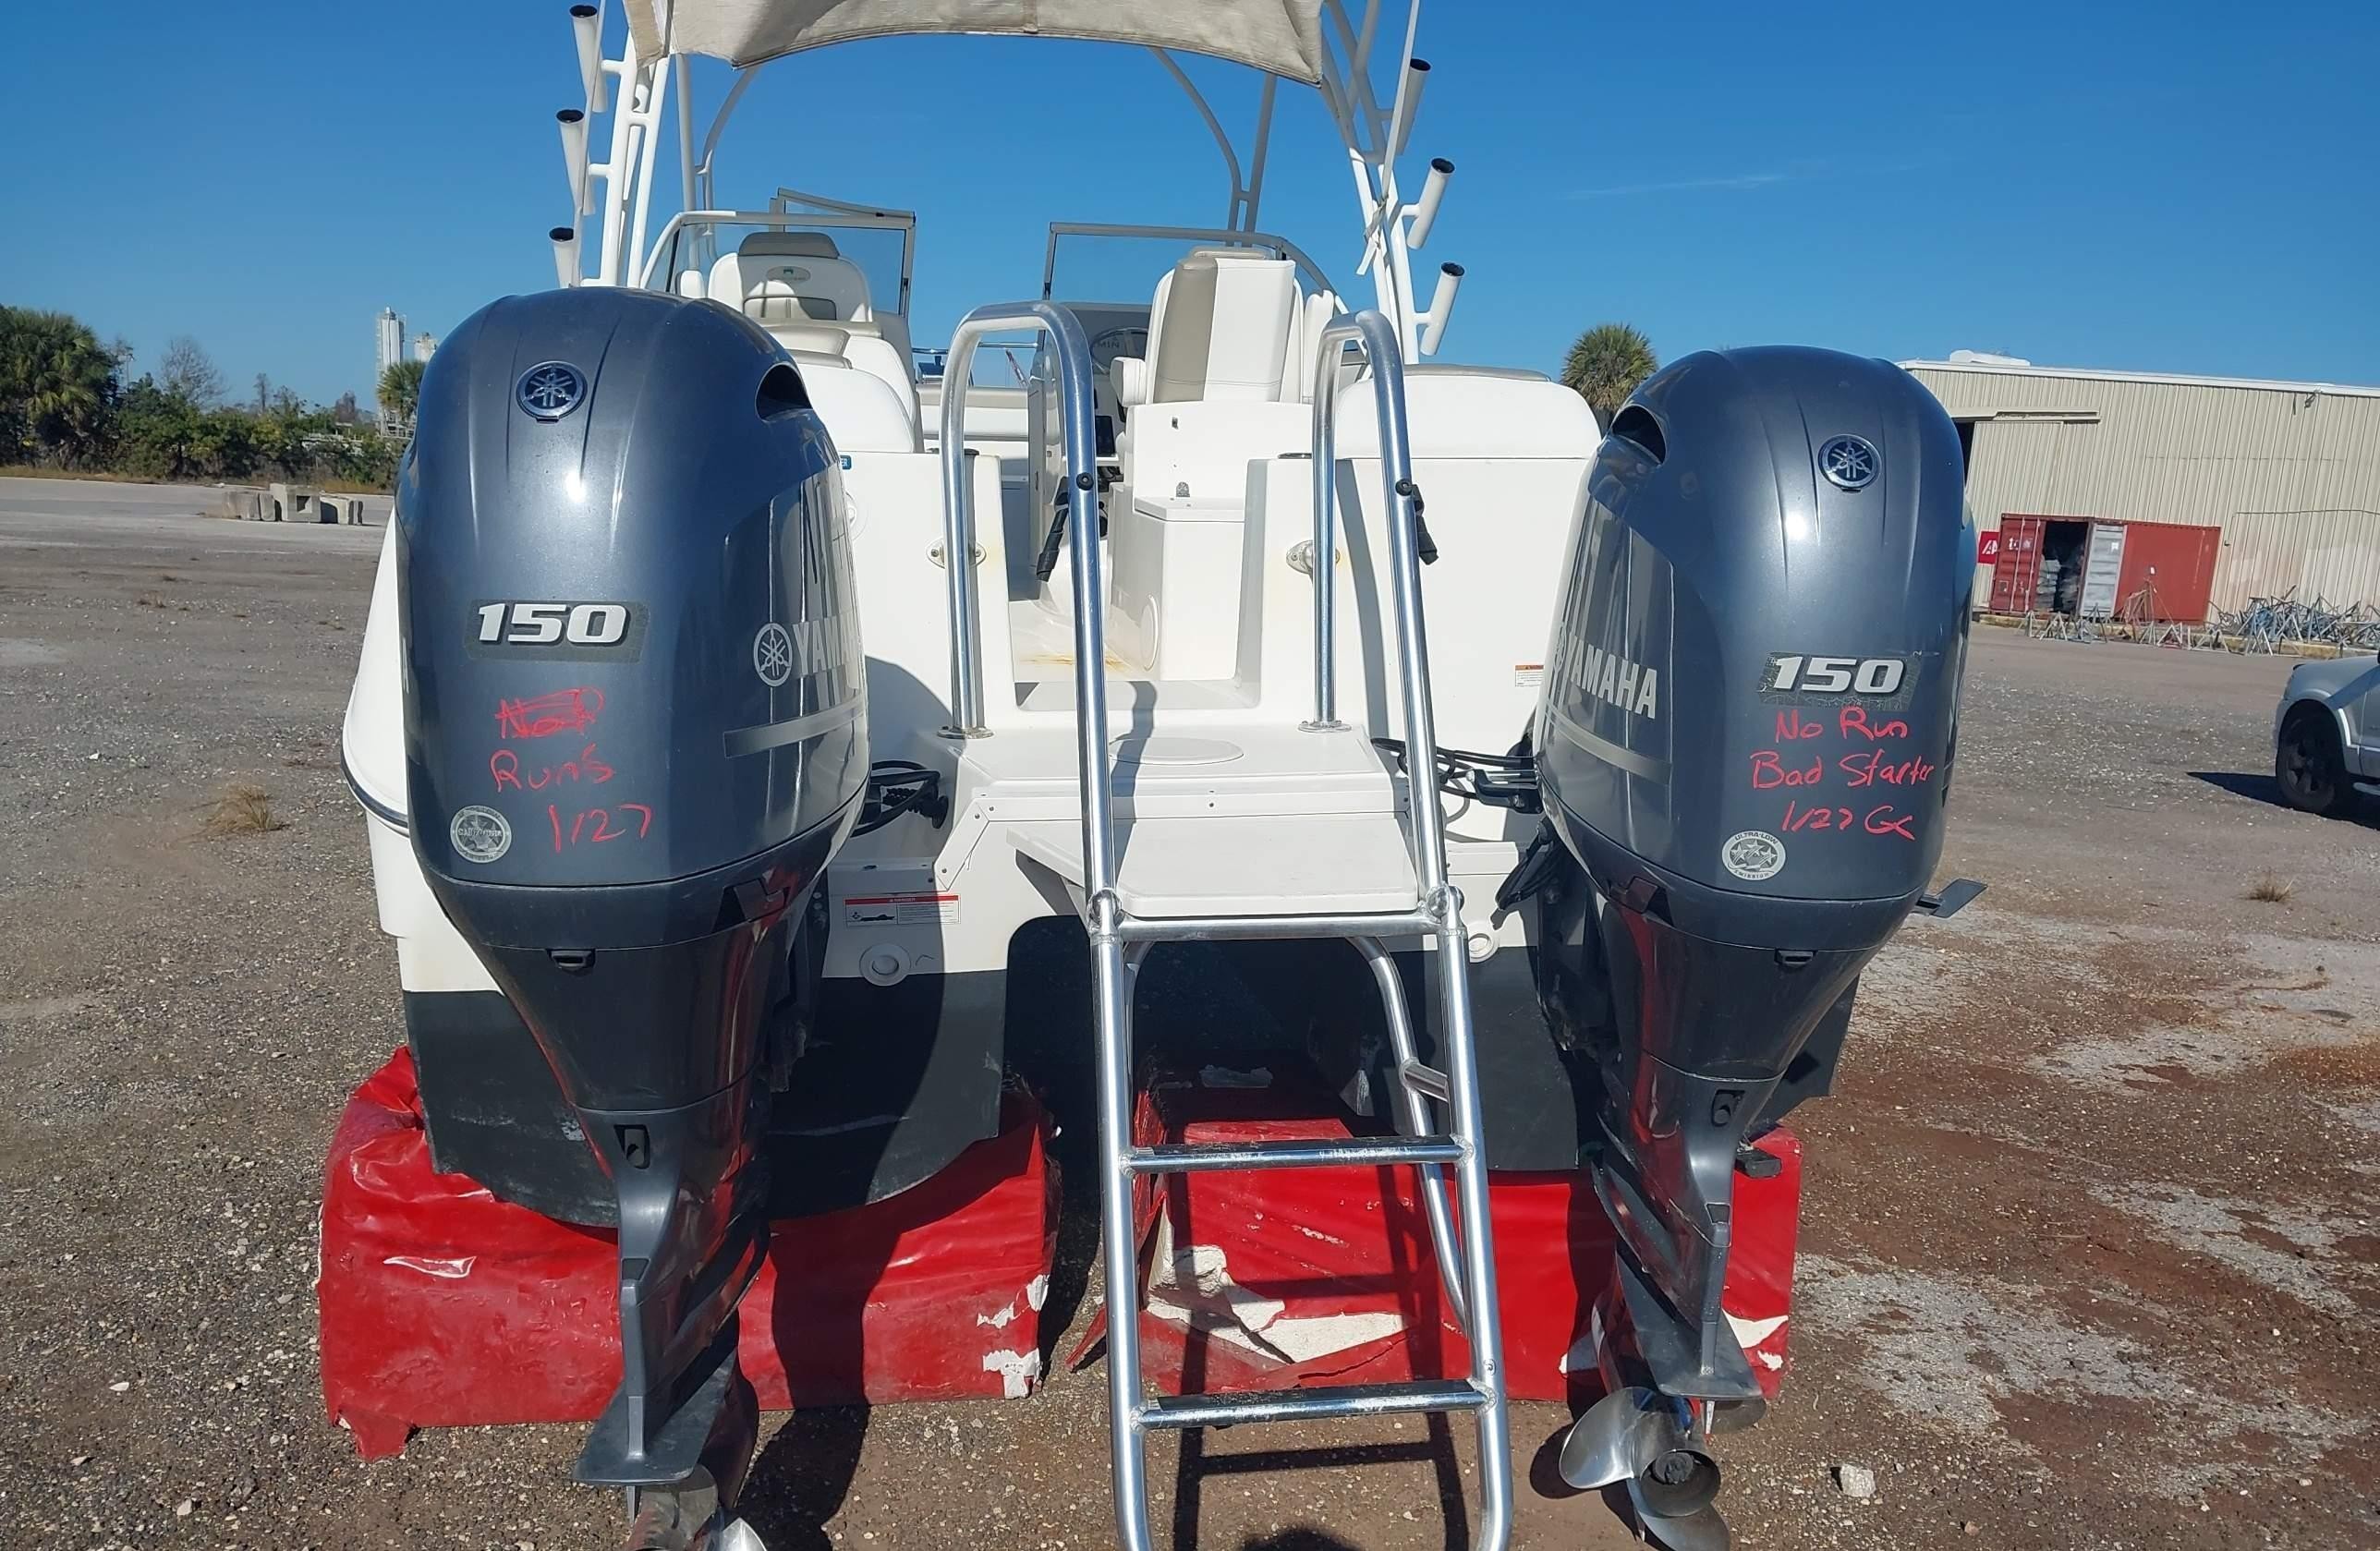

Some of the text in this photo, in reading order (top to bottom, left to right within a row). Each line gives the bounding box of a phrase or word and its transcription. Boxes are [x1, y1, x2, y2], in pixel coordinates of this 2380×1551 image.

[478, 602, 628, 645] 150
[1562, 632, 1658, 720] YAMAHA
[1772, 656, 1905, 694] 150
[1775, 704, 1909, 743] No Run
[1749, 750, 1823, 789] Bad
